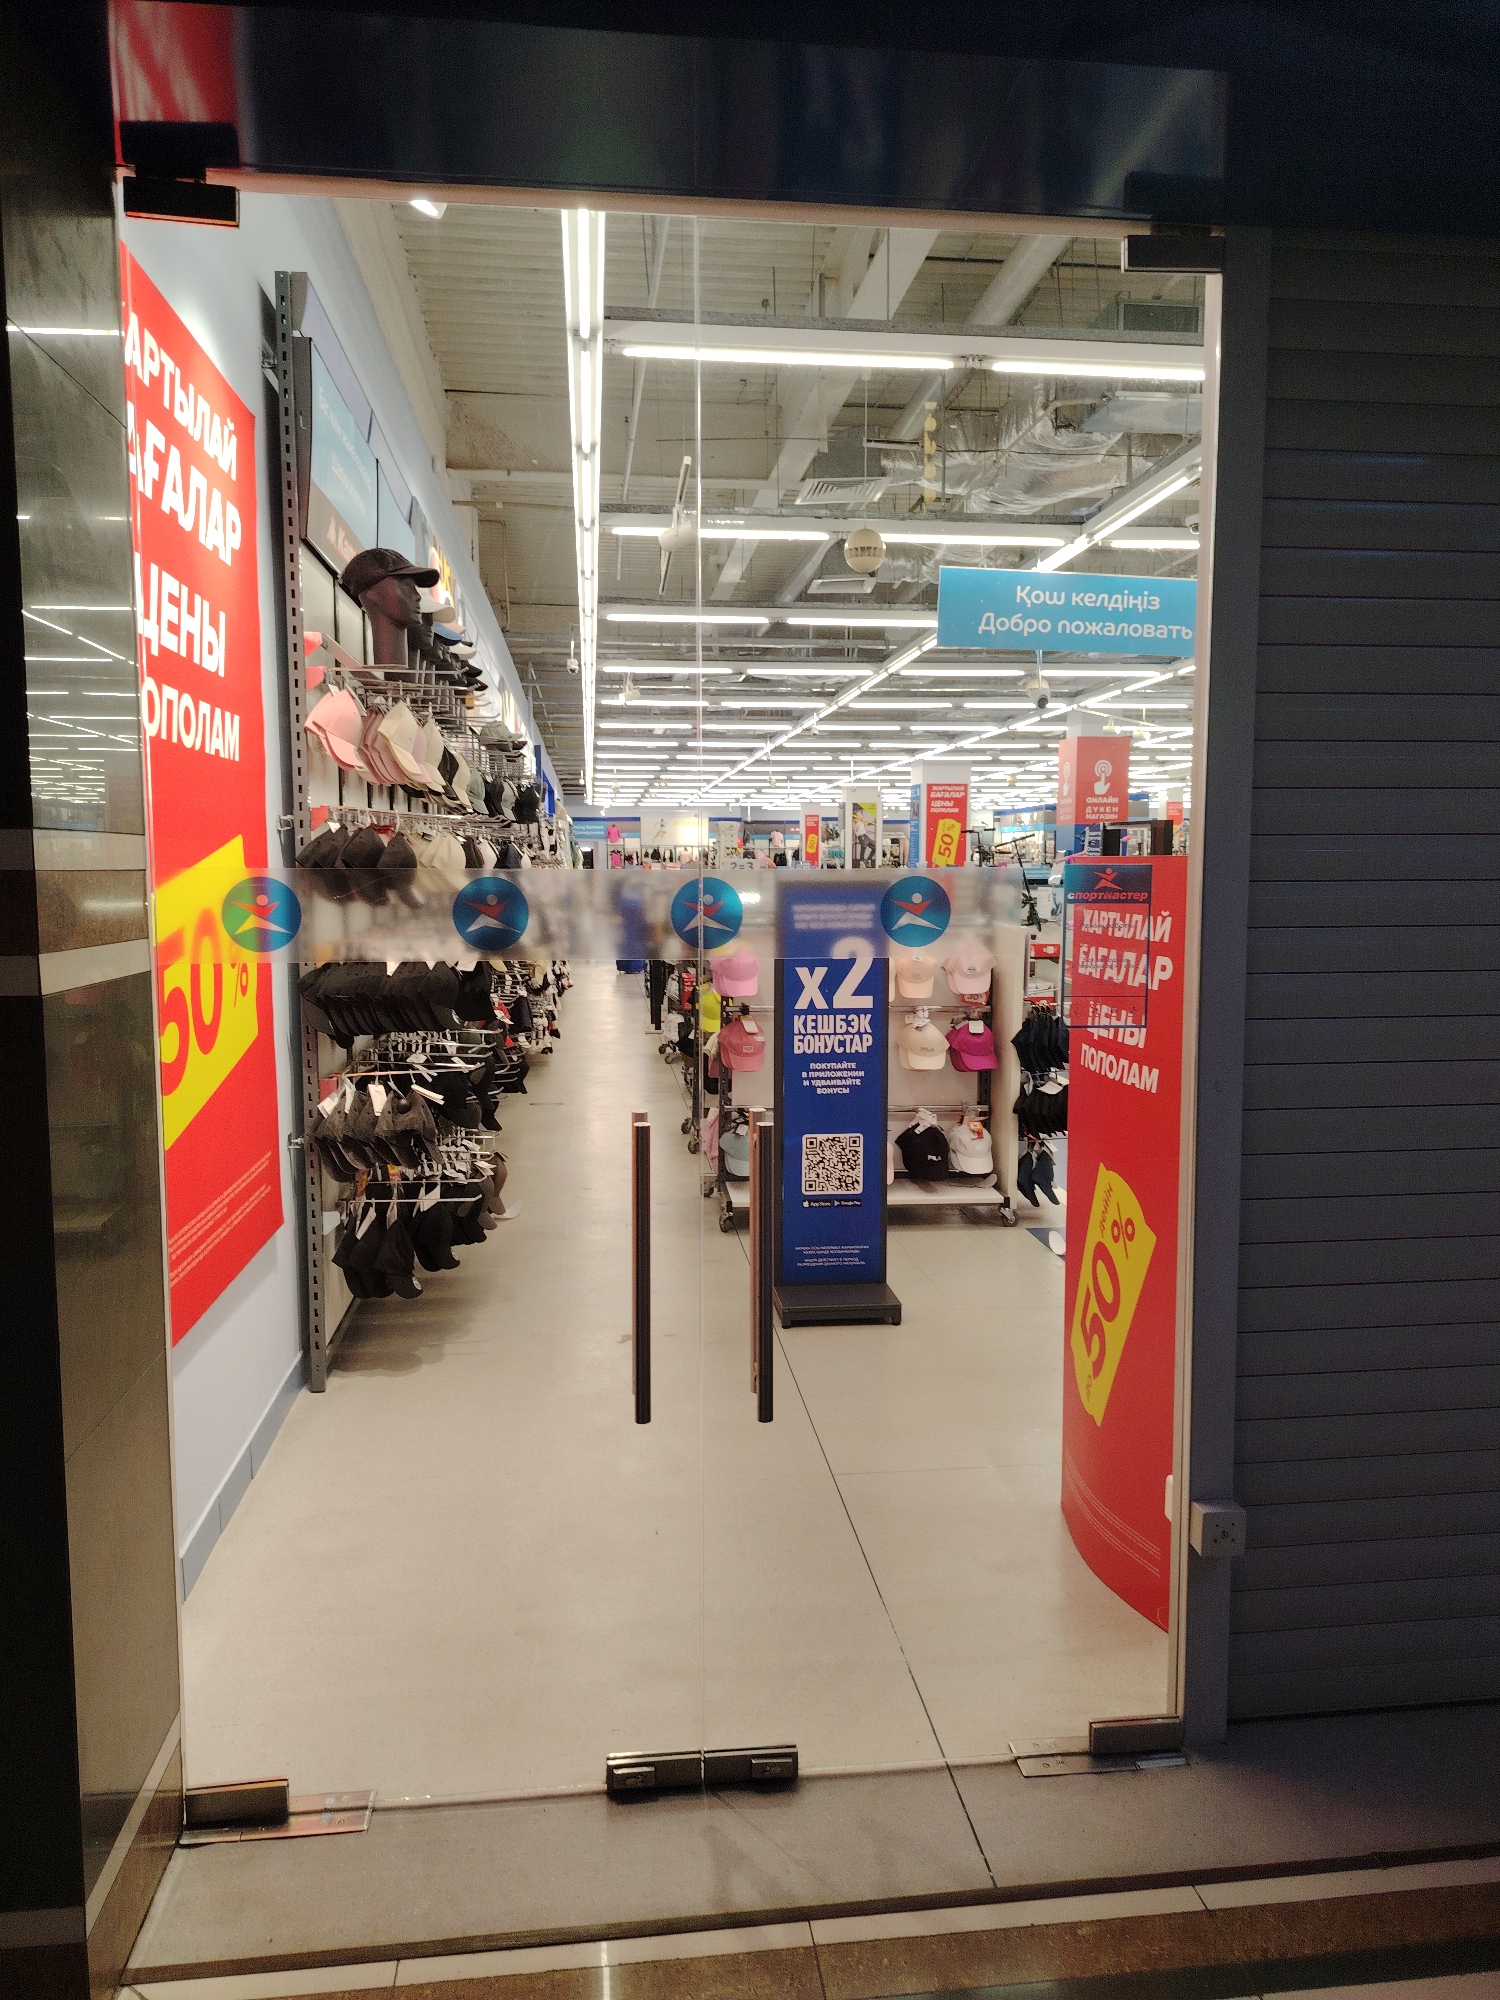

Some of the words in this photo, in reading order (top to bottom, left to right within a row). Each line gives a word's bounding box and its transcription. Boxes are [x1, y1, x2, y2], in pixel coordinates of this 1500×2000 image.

[124, 311, 237, 481] АРТЫЛАЙ
[127, 400, 241, 566] АҒАЛАР
[1016, 585, 1065, 607] Қош
[1071, 590, 1160, 612] келдіңіз
[134, 551, 226, 678] ЦЕНЫ
[978, 612, 1051, 636] Добро
[1057, 619, 1193, 640] пожаловать
[141, 676, 240, 762] ОПОЛАМ
[1086, 796, 1119, 804] ОНЛАЙН
[1067, 890, 1149, 902] спортмастер
[1081, 909, 1172, 943] ЖАРТЫЛАЙ
[793, 1014, 872, 1034] КЕШБЭК
[793, 1034, 873, 1054] БОНУСТАР
[810, 1061, 856, 1070] ПОКУПАЙТЕ
[1080, 1043, 1159, 1094] ПОПОЛАМ
[811, 1078, 861, 1086] УДВАИВАЙТЕ
